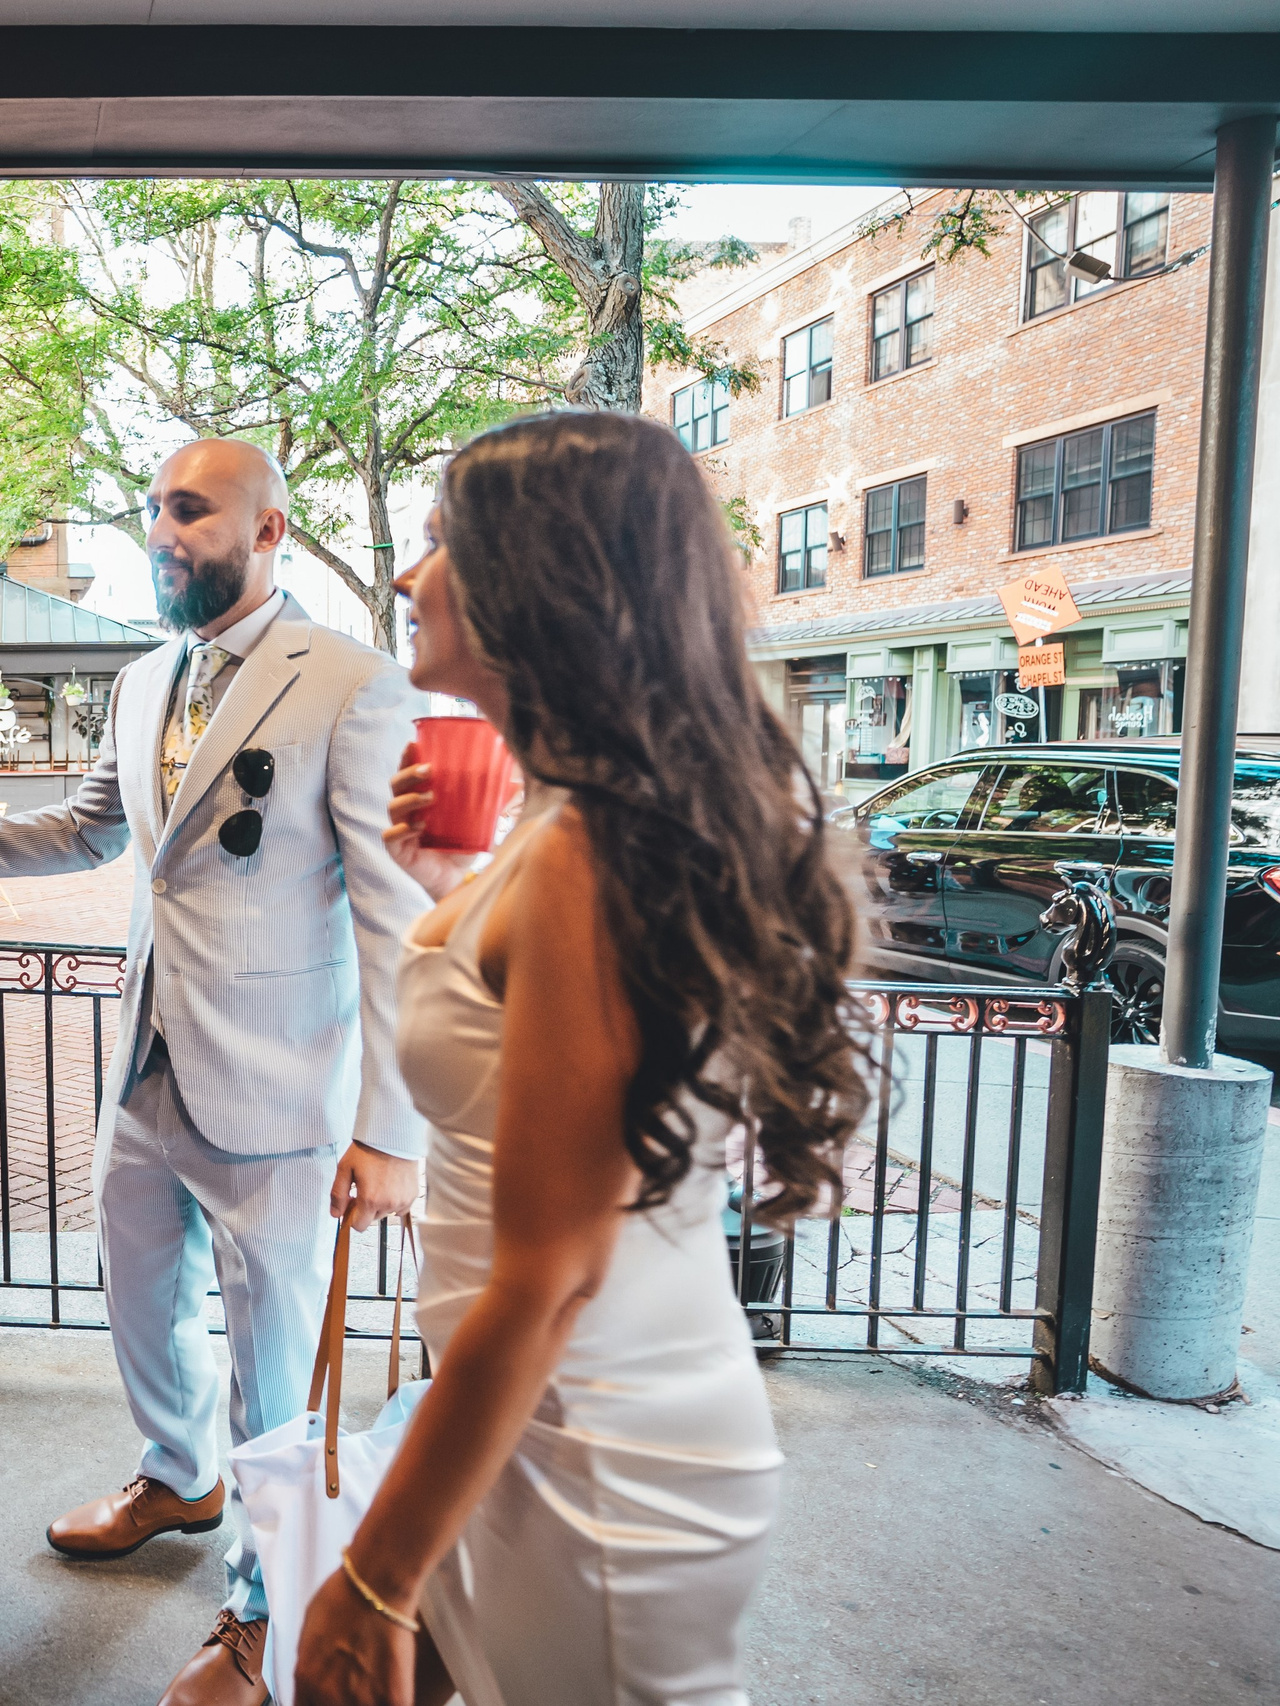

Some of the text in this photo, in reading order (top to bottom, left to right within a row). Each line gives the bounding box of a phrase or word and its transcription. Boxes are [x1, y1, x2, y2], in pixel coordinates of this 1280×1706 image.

[1024, 579, 1069, 601] AHEAD
[1020, 651, 1063, 667] ORANGE ST
[1021, 670, 1062, 687] CHAPEL ST
